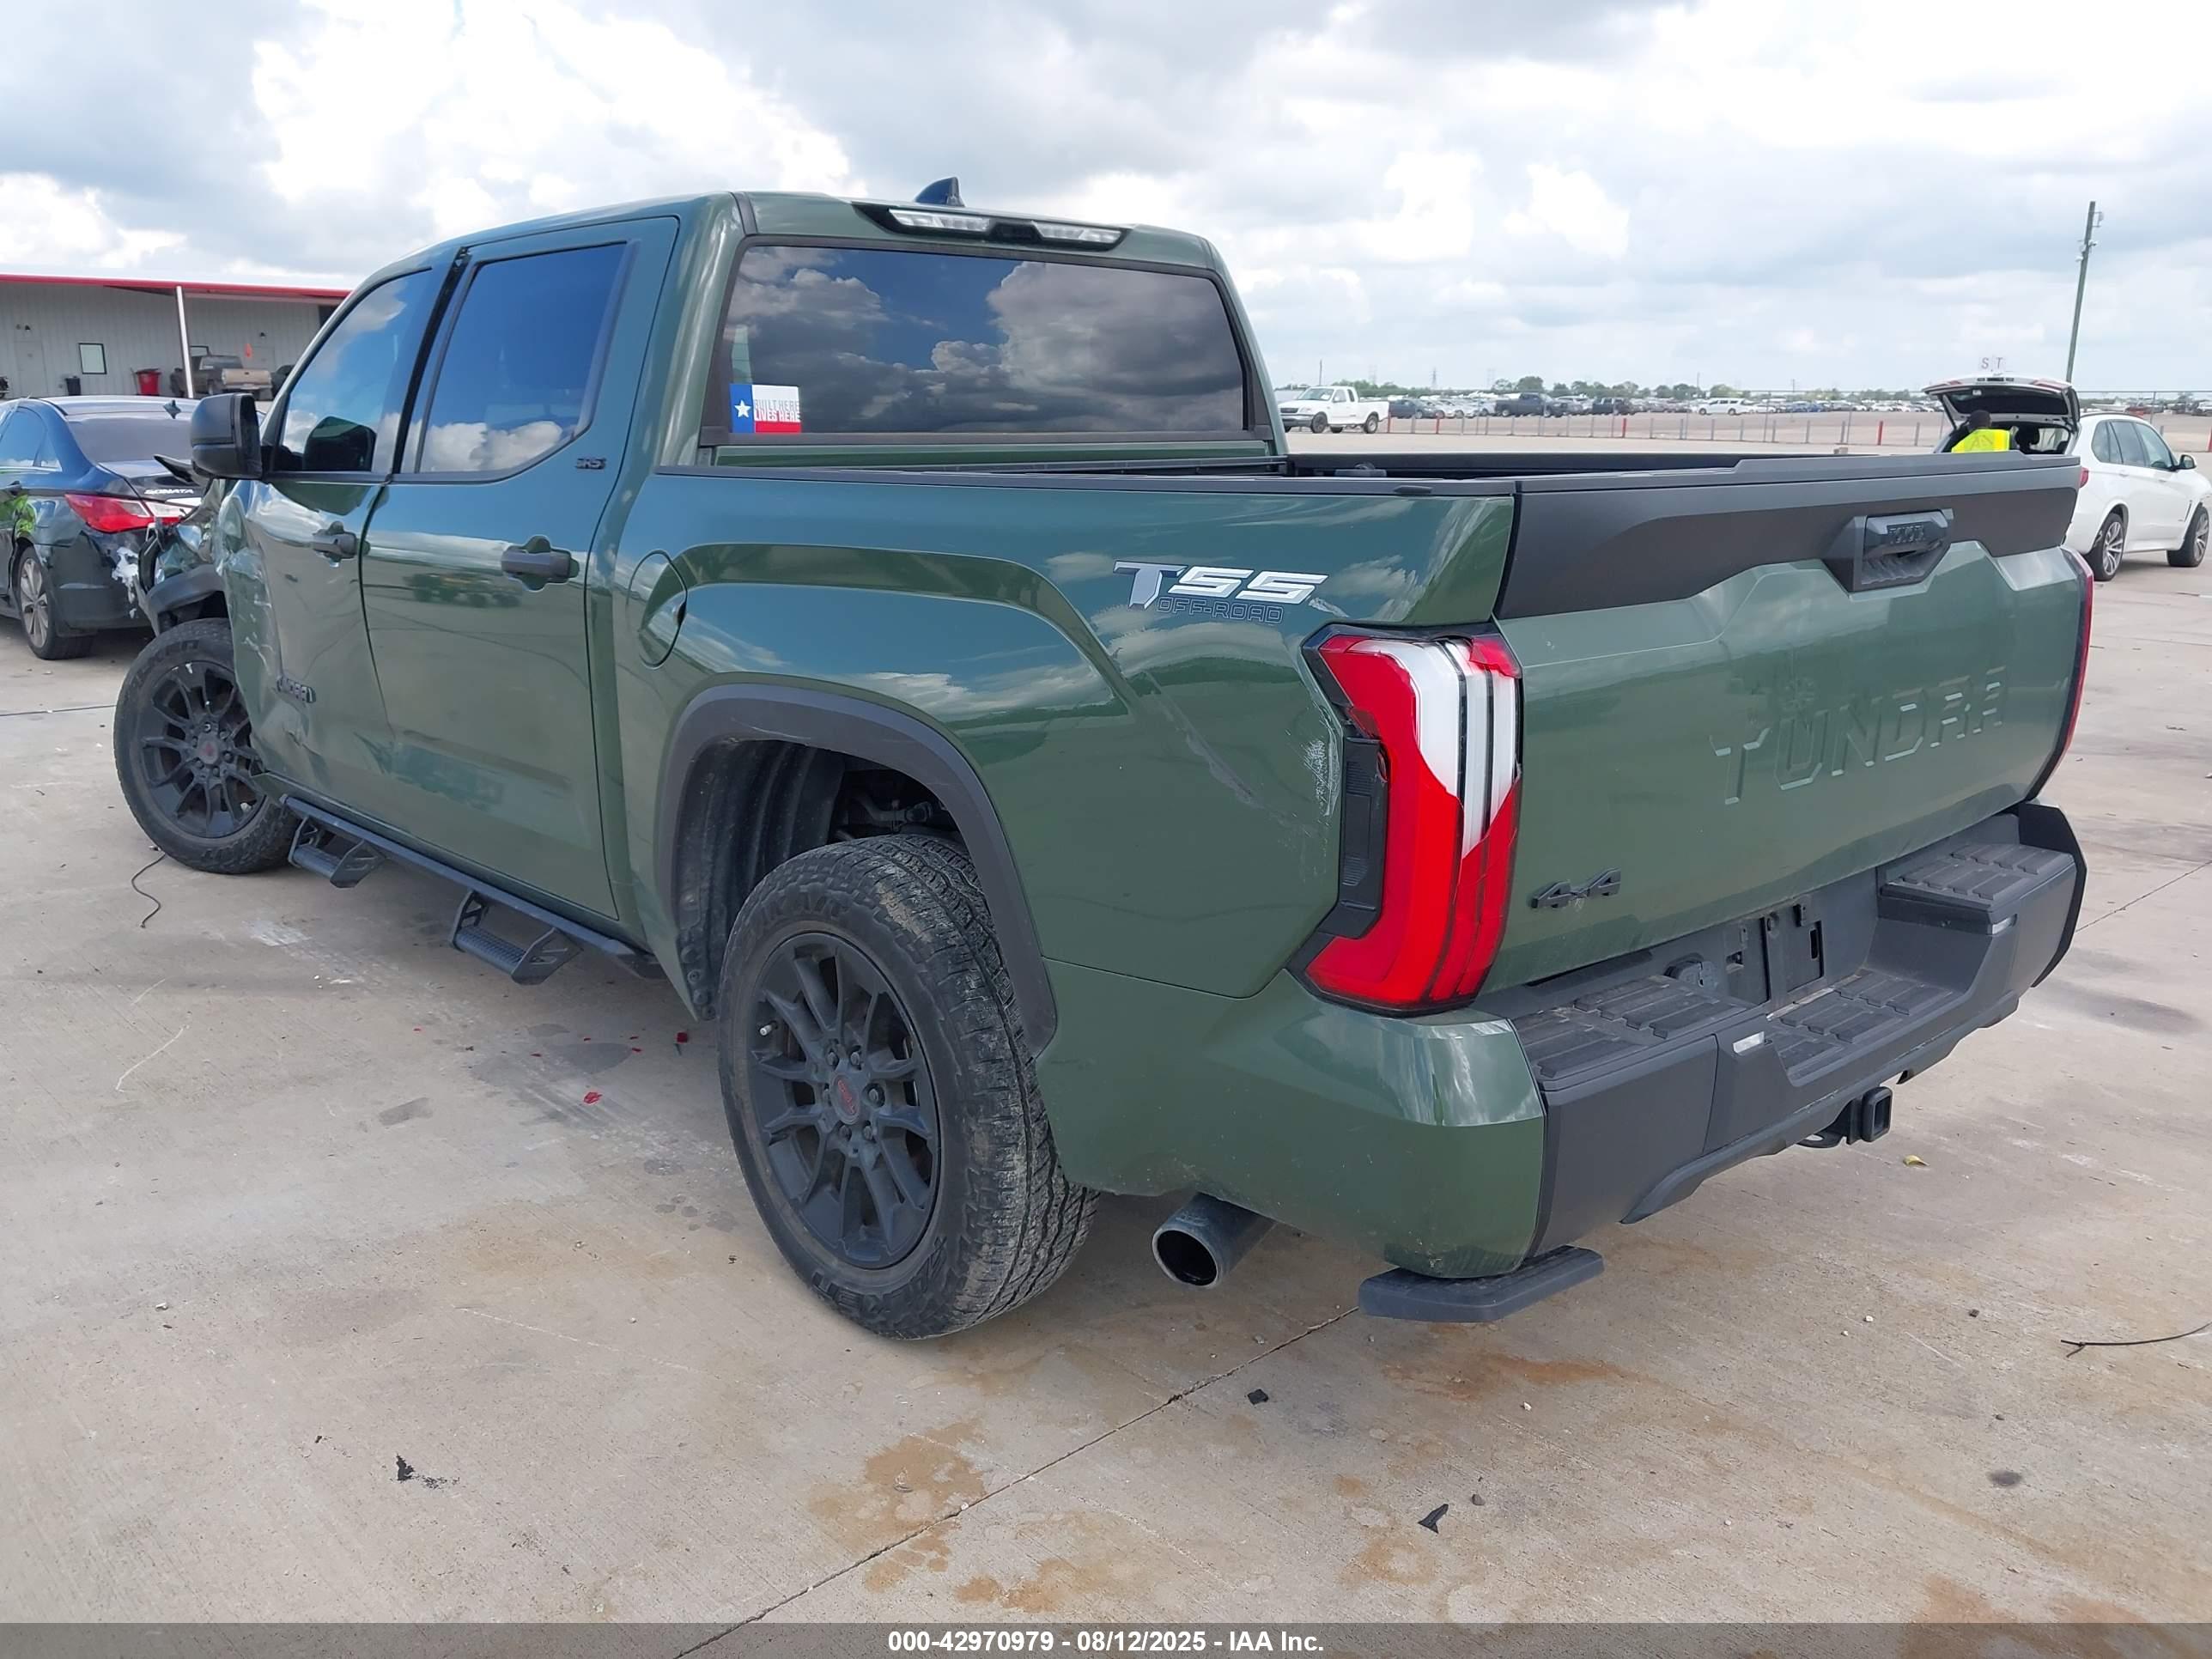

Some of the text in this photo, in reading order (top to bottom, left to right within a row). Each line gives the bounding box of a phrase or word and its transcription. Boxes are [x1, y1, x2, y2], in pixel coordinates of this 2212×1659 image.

[755, 398, 799, 412] BUILT HERE
[779, 411, 801, 422] HERE
[1158, 597, 1284, 623] OFF-ROAD
[1709, 665, 2008, 805] TUNDRA
